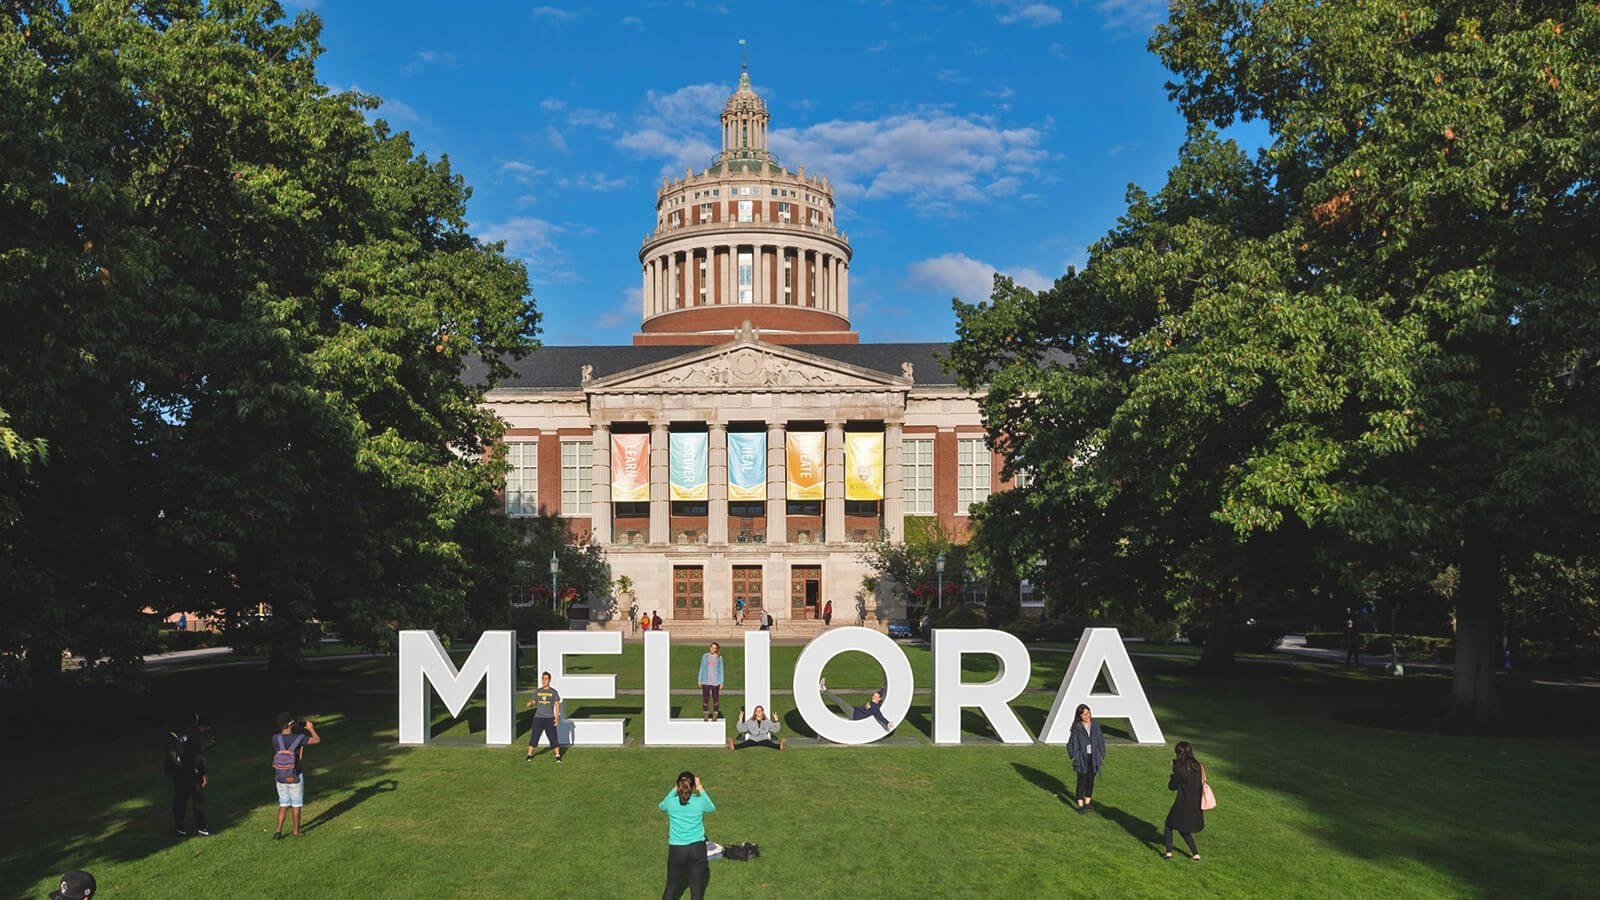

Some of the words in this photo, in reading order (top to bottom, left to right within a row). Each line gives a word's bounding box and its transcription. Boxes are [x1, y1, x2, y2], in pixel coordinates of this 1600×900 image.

[625, 445, 637, 477] LEARN
[683, 439, 696, 482] ISCOVER
[742, 447, 754, 472] HEAL
[800, 441, 812, 479] REATE
[398, 626, 1166, 746] MELIORA
